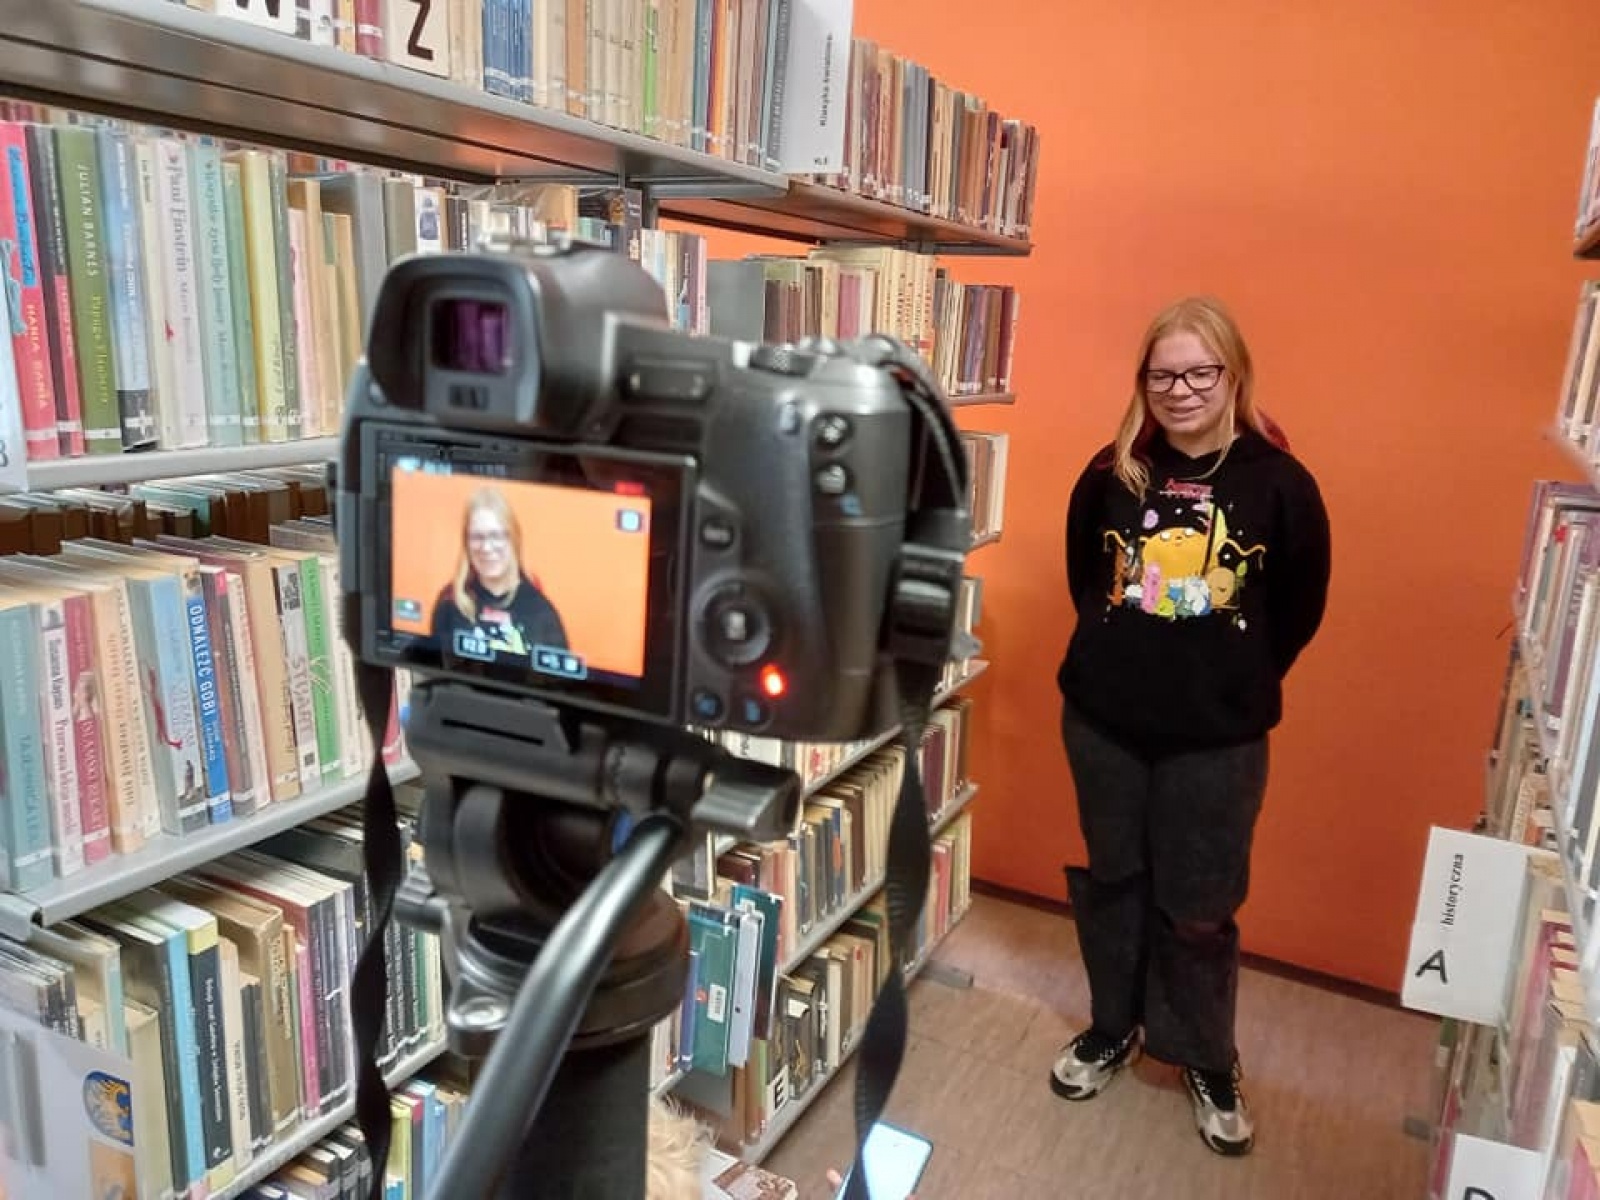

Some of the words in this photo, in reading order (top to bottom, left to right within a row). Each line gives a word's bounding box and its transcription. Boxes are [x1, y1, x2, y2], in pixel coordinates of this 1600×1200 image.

[77, 164, 95, 216] JULIAN
[82, 222, 100, 277] BARNES
[26, 304, 41, 352] HANIA
[1441, 853, 1464, 926] historyczna
[1415, 949, 1448, 984] A
[774, 1077, 784, 1110] E
